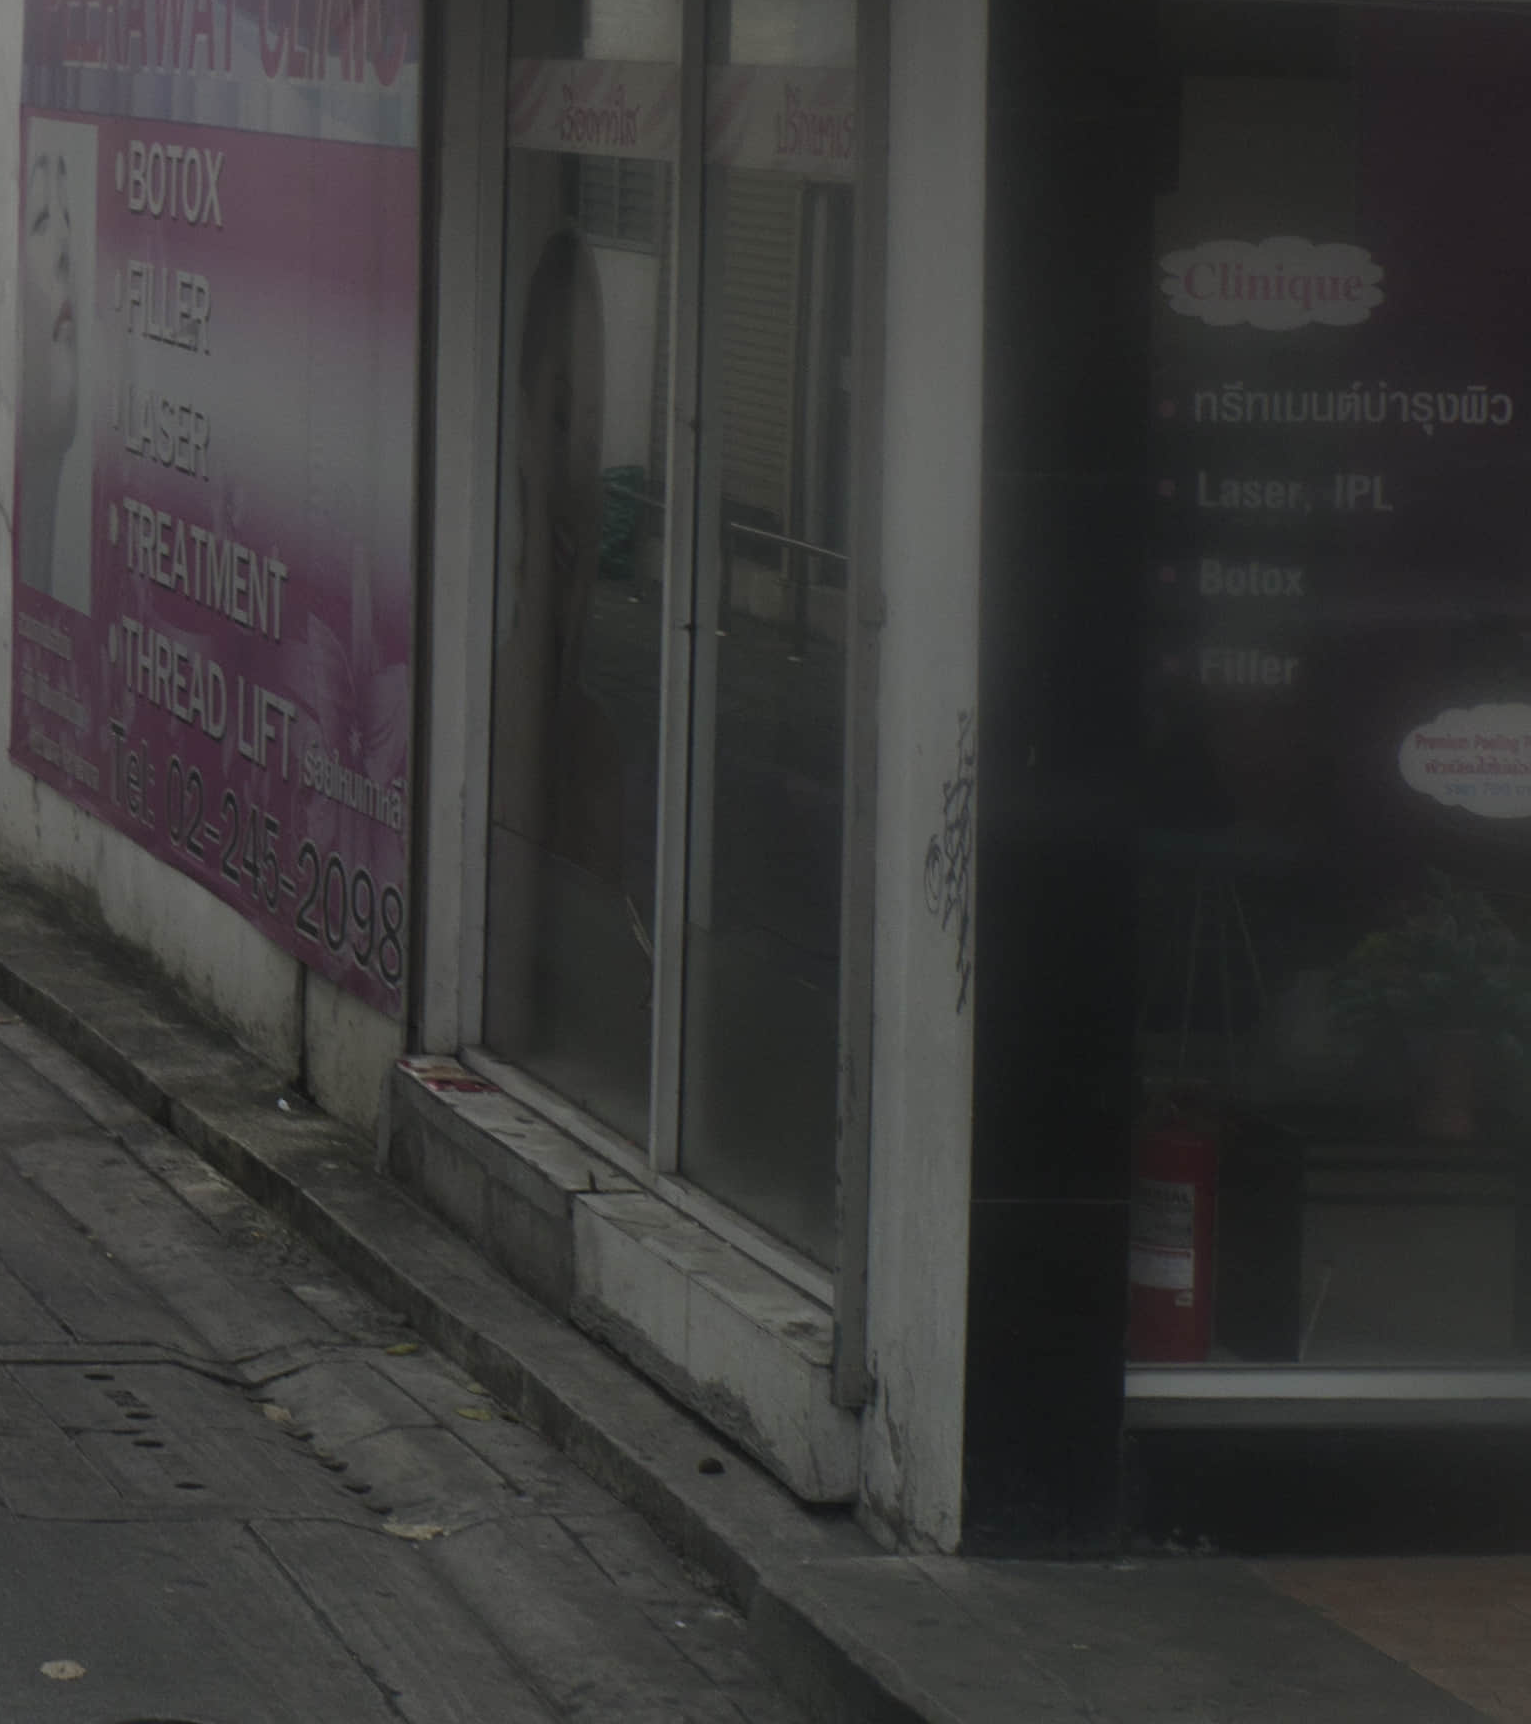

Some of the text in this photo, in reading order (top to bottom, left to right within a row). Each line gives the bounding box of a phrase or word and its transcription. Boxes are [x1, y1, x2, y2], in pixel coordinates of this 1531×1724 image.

[128, 140, 225, 231] BOTOX
[127, 260, 212, 355] FILLER
[1183, 261, 1364, 310] Clinique
[124, 386, 211, 482] LASER
[1193, 381, 1514, 437] ทรีทเมนต์บำรุงผิว
[1196, 471, 1313, 514] Laser,
[124, 498, 288, 641] TREATMENT
[1199, 558, 1306, 597] Botox
[122, 616, 227, 740] THREAD
[239, 685, 297, 783] LIFT
[1200, 647, 1300, 686] Filler
[166, 756, 406, 990] 02-245-2098
